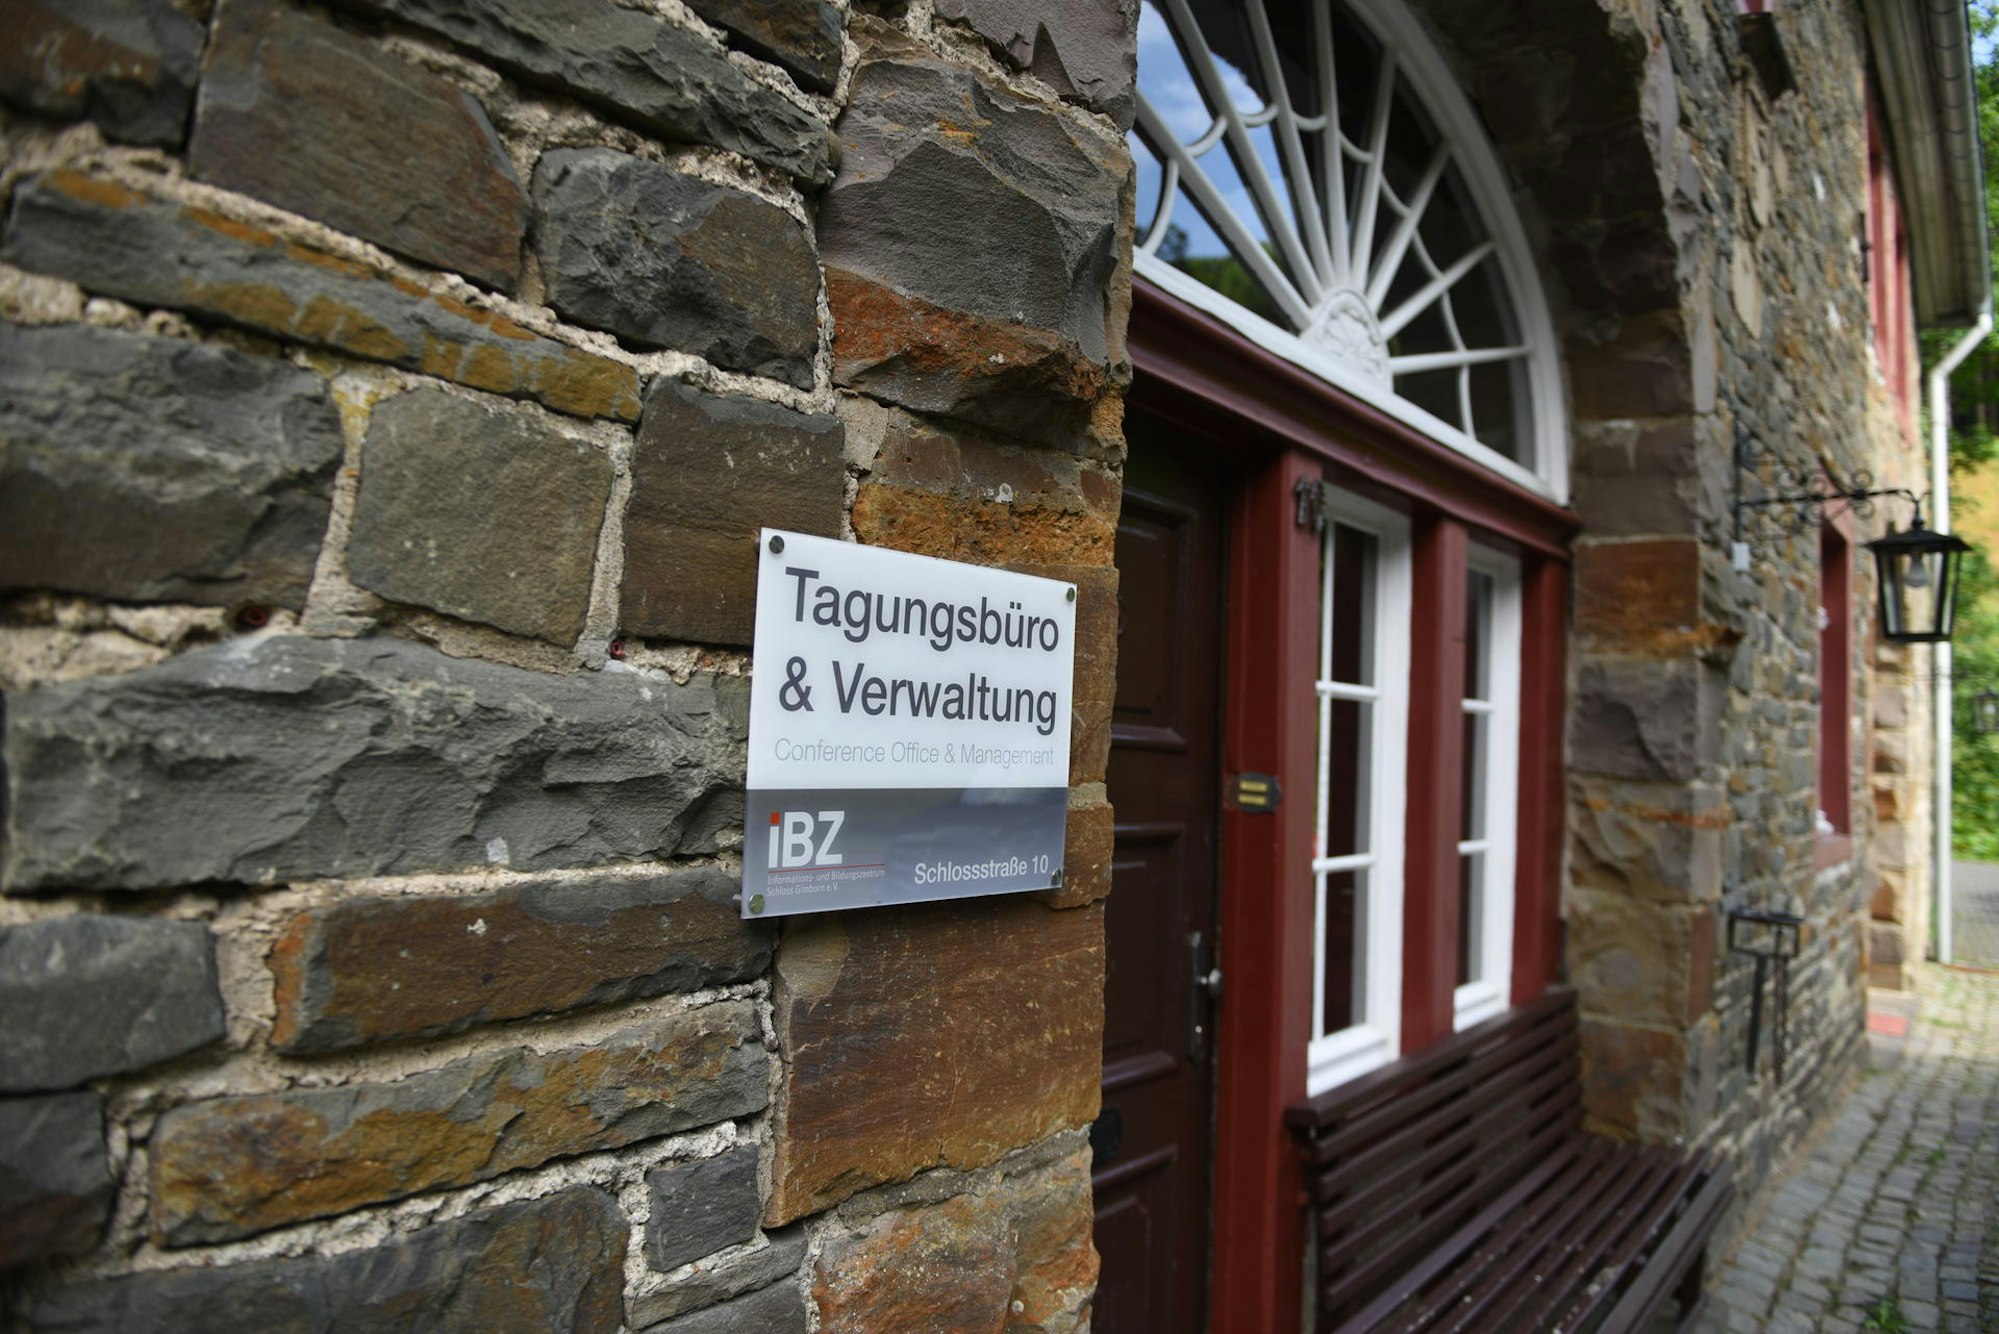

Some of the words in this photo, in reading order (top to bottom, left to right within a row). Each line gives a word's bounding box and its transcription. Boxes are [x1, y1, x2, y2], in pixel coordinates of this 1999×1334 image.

[785, 567, 1059, 652] Tagungsbüro
[779, 656, 814, 712] &
[832, 660, 1057, 736] Verwaltung
[774, 737, 886, 763] Conference
[891, 741, 939, 763] Office
[944, 742, 955, 764] &
[960, 743, 1054, 769] Management
[816, 871, 830, 881] und
[914, 855, 1028, 884] Schlossstraße
[1032, 855, 1048, 873] 10
[766, 885, 795, 897] Schloss
